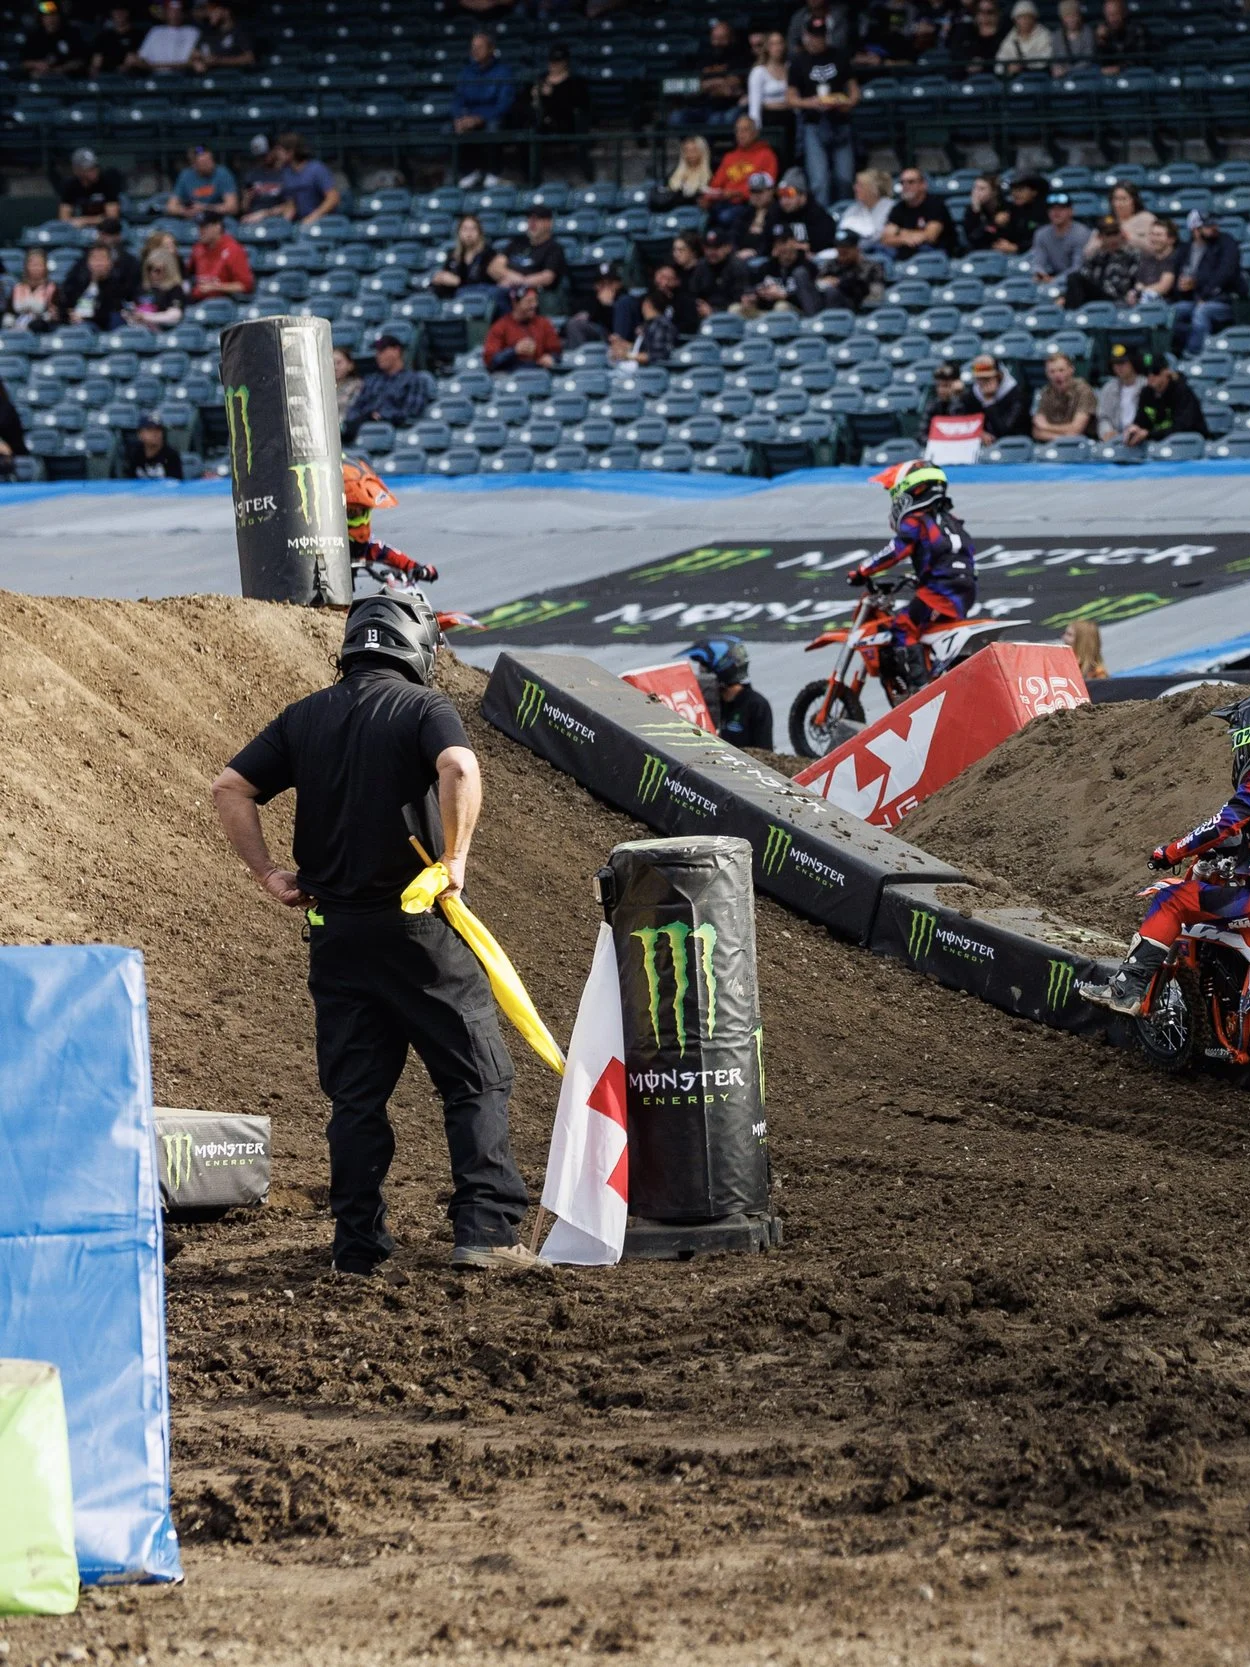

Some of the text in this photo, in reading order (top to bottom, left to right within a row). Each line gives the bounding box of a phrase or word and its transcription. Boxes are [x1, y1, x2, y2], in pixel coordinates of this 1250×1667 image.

[235, 495, 277, 518] STER
[287, 536, 344, 549] MONSTER
[543, 701, 596, 744] MONSTER
[664, 776, 718, 817] MONSTER
[789, 847, 846, 887] MONSTER
[795, 865, 834, 889] ENERGY
[935, 928, 995, 960] MONSTER
[942, 946, 985, 965] ENERGY
[629, 1067, 745, 1094] MONSTER
[643, 1093, 730, 1106] ENERGY
[194, 1141, 266, 1159] MONSTER
[205, 1158, 255, 1167] ENERGY
